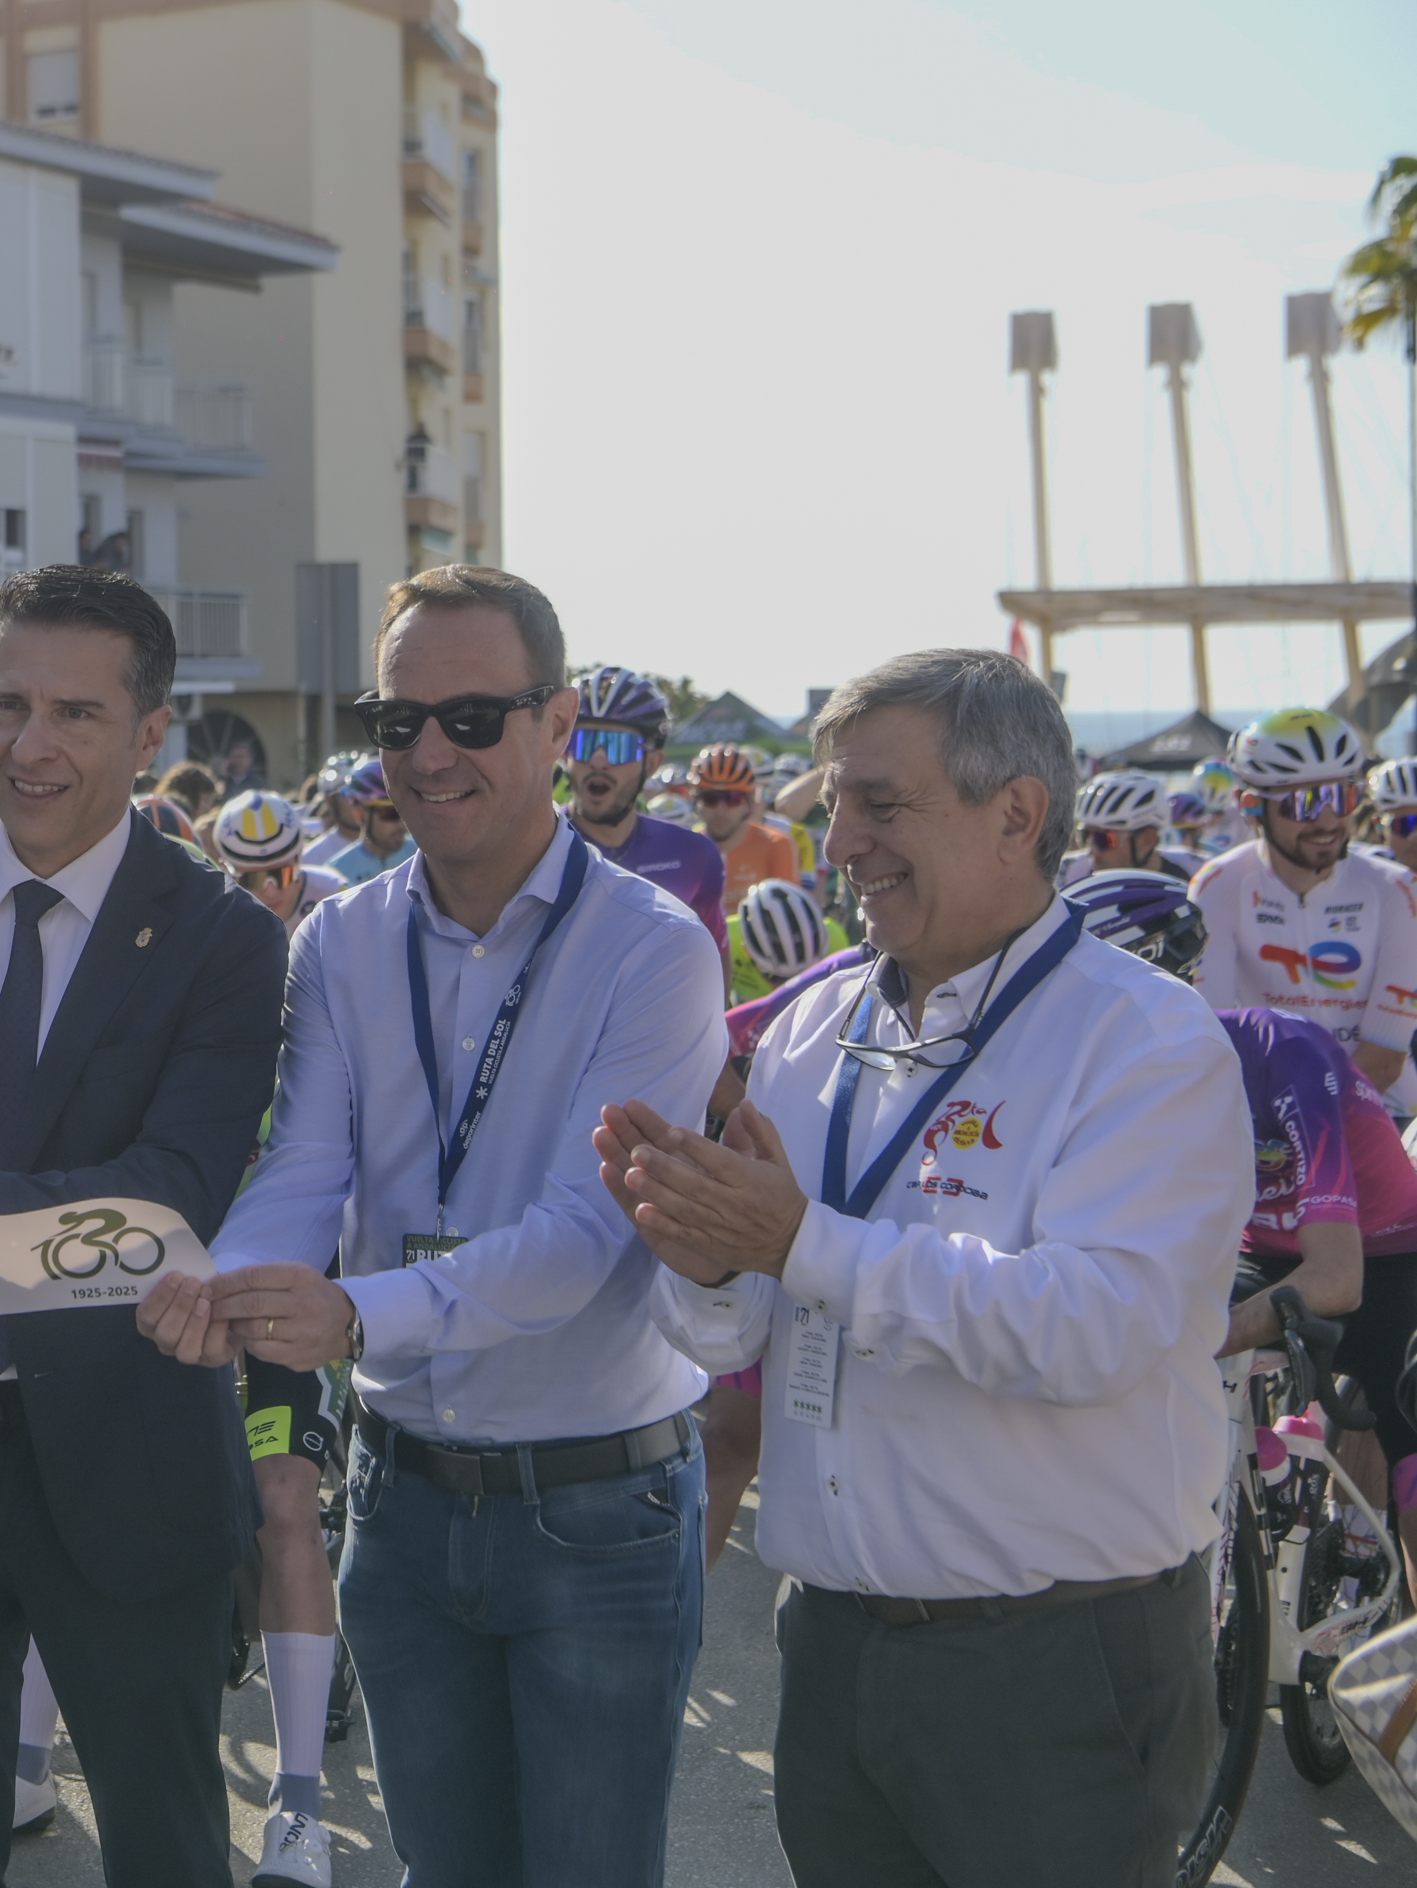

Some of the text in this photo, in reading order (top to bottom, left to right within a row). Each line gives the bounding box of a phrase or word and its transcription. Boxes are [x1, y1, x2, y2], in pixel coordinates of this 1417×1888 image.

[479, 1019, 507, 1083] RUTA DEL SOL
[463, 1111, 482, 1149] deporinter
[1284, 1120, 1306, 1185] CORTIZO
[71, 1285, 139, 1300] 1925-2025
